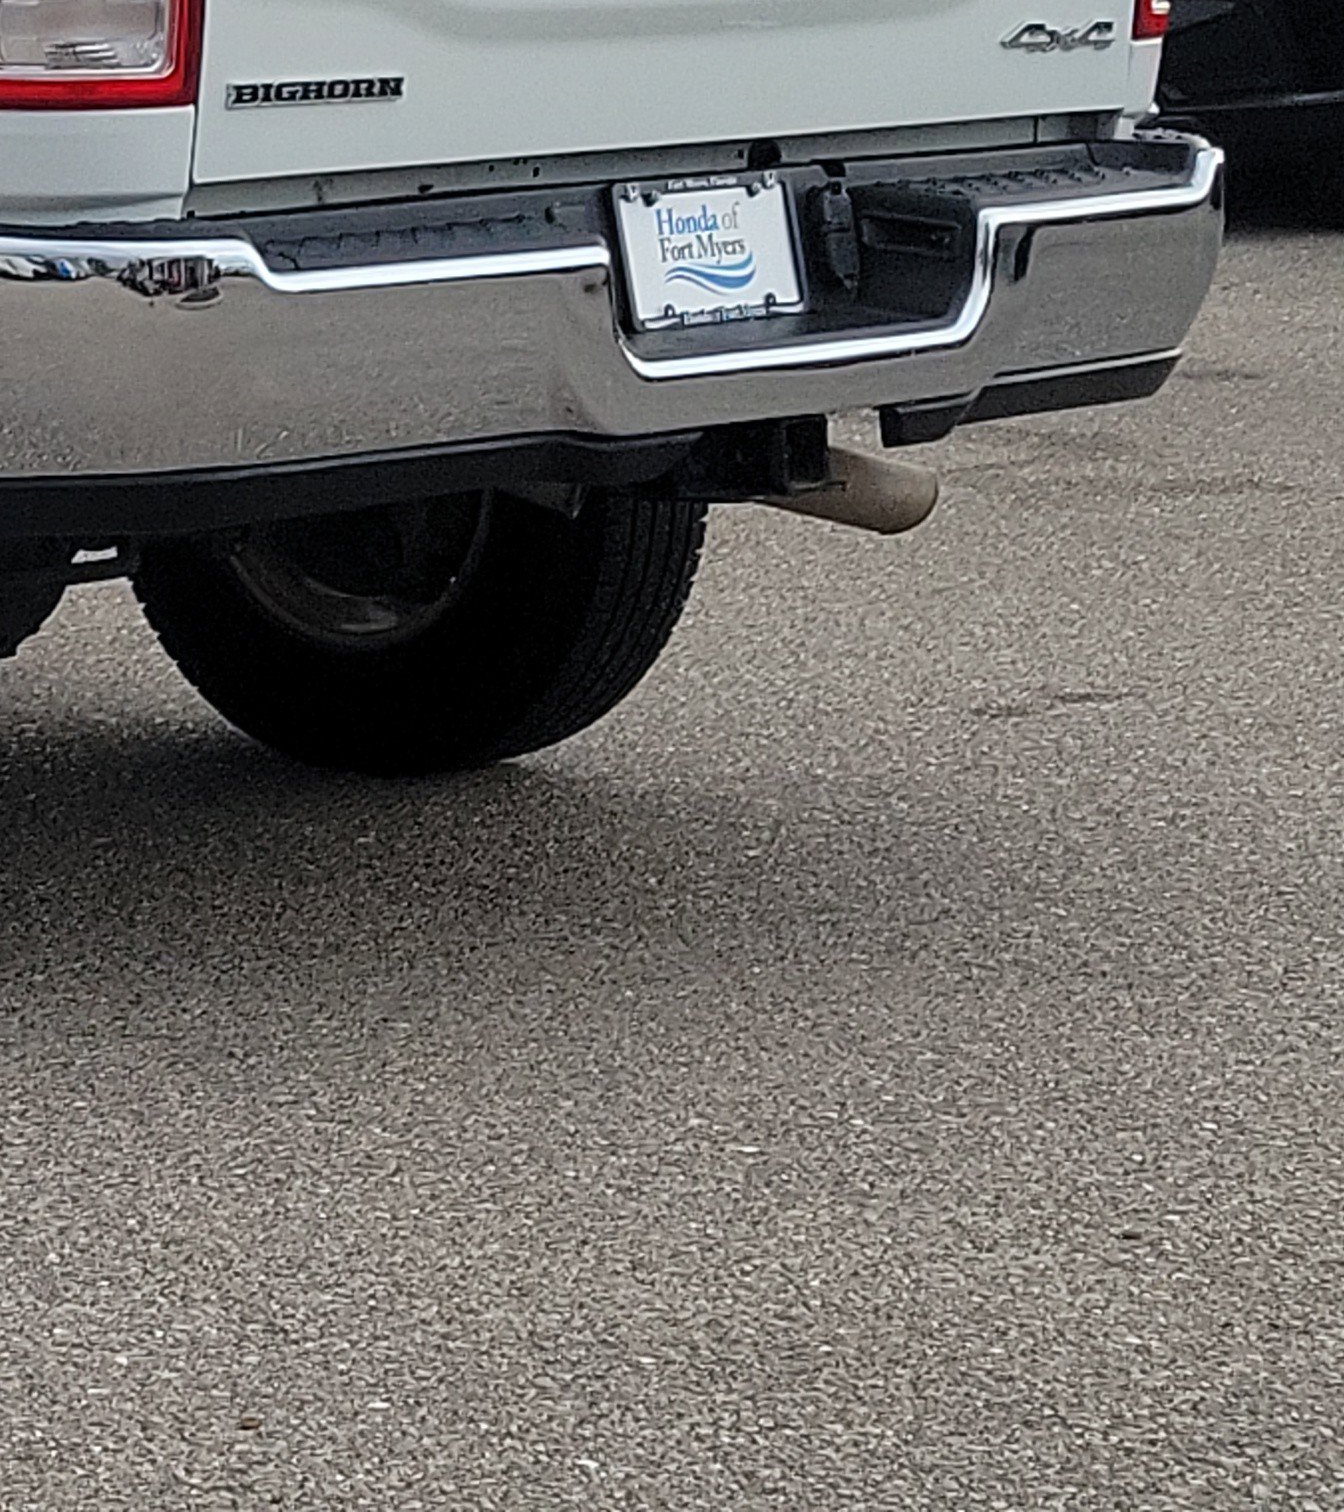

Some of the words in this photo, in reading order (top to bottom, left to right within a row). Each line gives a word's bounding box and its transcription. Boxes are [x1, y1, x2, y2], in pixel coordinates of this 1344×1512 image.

[226, 76, 404, 108] BIGHORN
[655, 203, 719, 236] Honda
[721, 201, 740, 230] of
[659, 236, 694, 263] Fort
[695, 233, 745, 264] Myers
